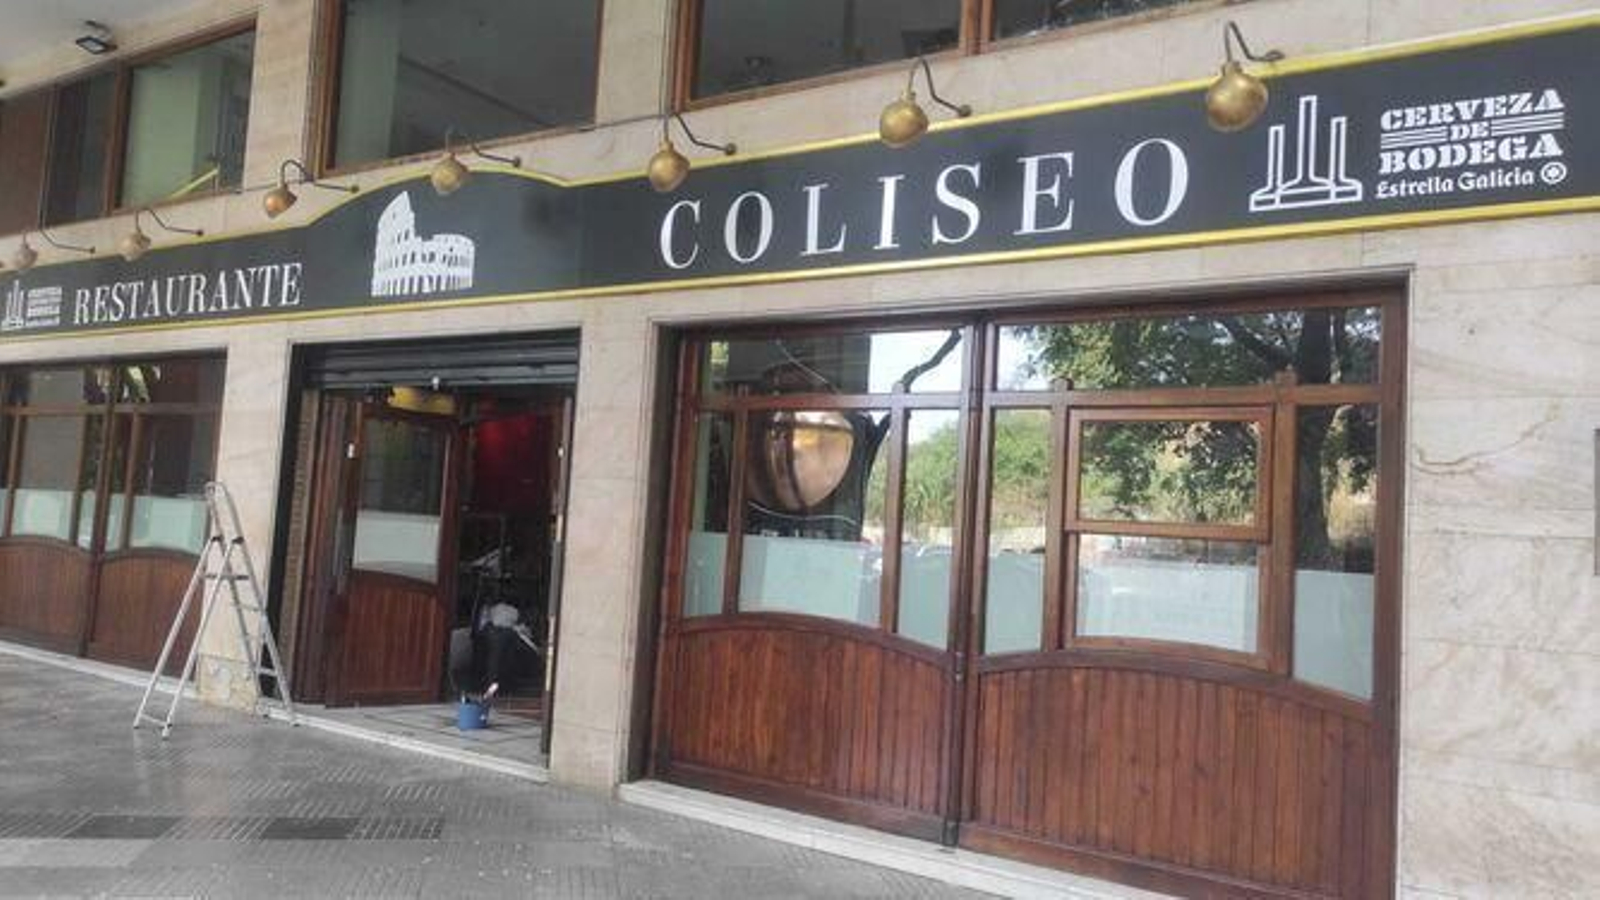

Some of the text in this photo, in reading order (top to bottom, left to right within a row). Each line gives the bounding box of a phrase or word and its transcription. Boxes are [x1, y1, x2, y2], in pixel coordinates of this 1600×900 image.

[1380, 89, 1564, 131] CERVEZA
[1450, 121, 1489, 141] DE
[1379, 133, 1563, 174] BODEGA
[1376, 167, 1534, 199] Estrella Galicia
[75, 137, 1189, 324] RESTAURANTE COLISEO
